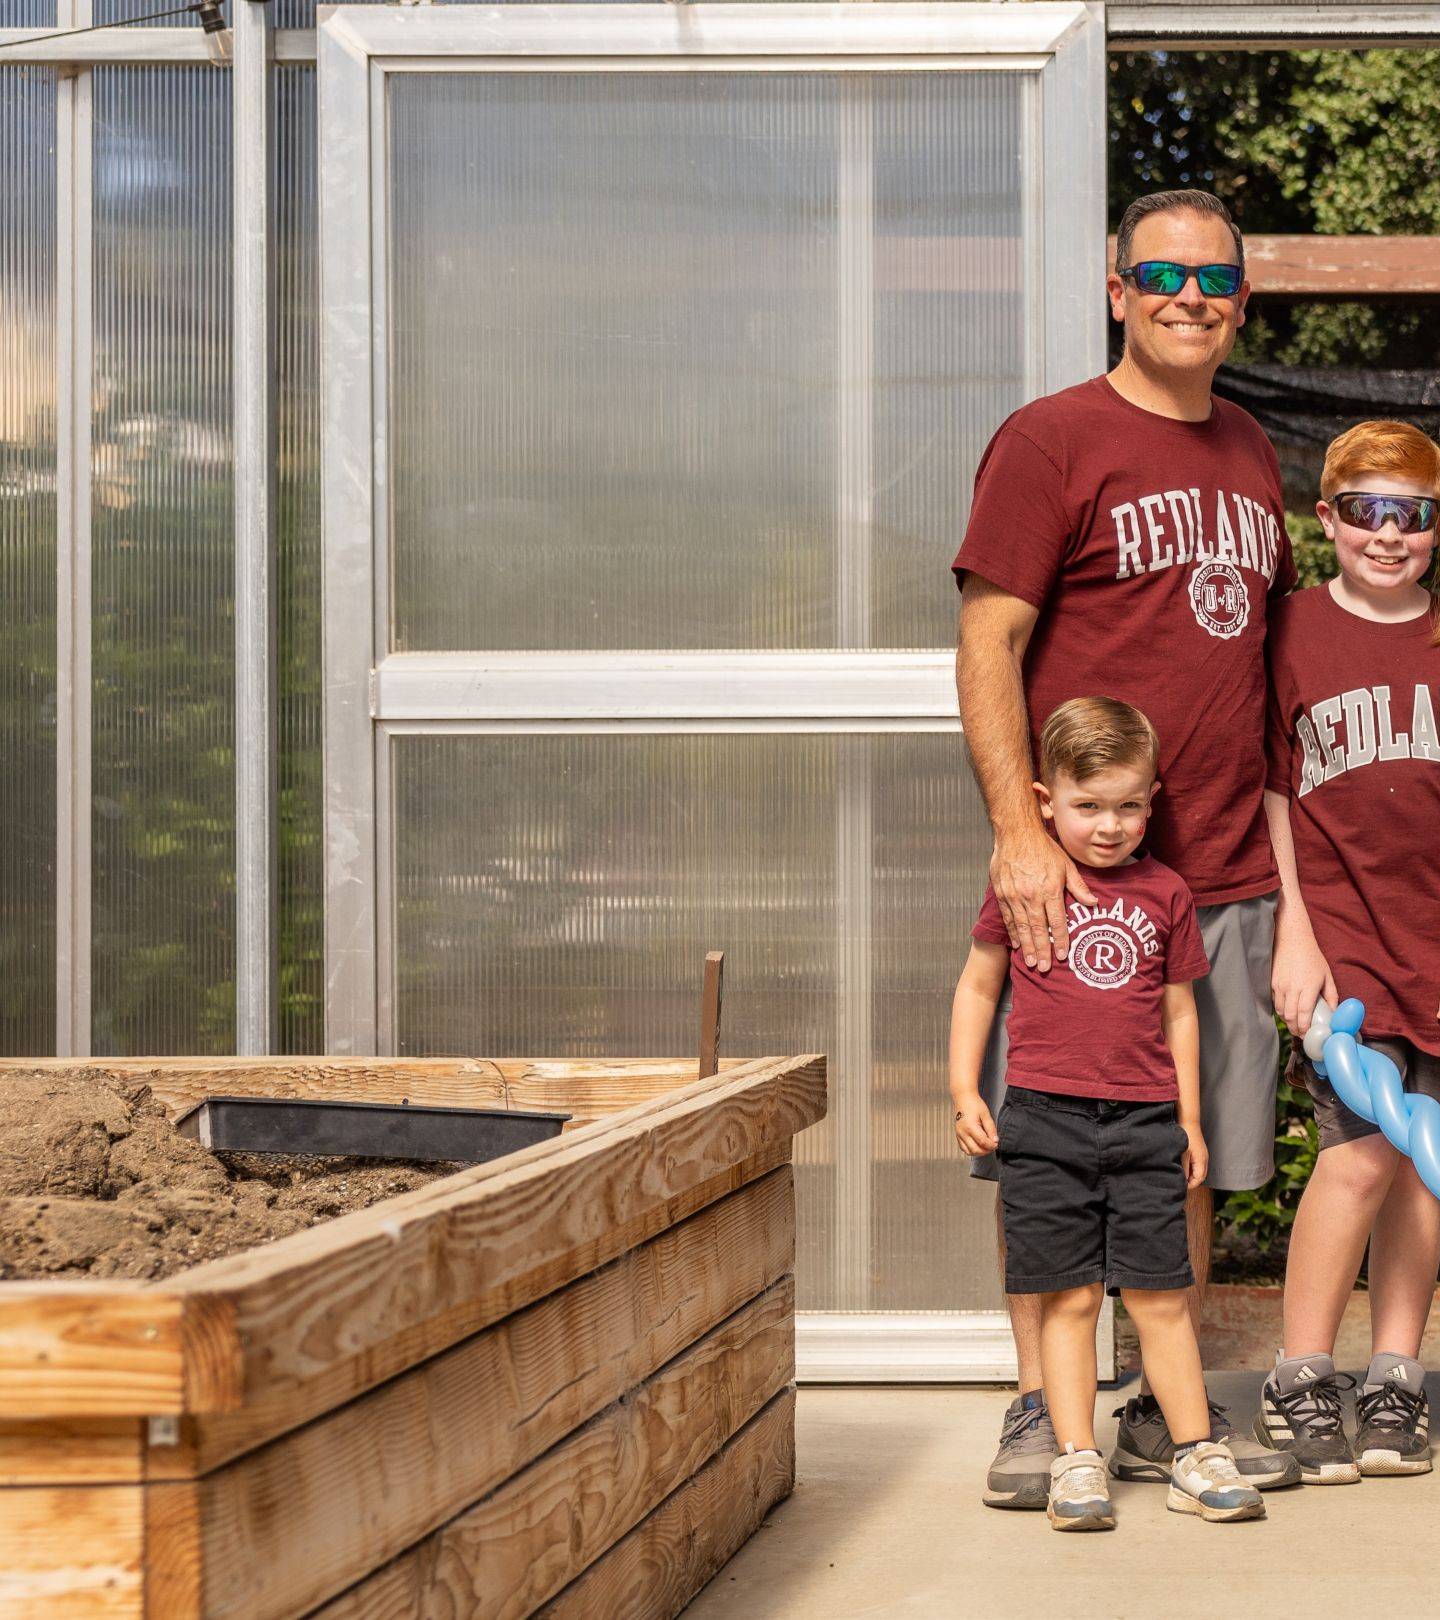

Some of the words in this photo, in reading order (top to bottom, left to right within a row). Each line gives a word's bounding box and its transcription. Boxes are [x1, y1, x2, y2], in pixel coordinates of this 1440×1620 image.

[1194, 566, 1213, 600] UNIVERSITY
[1226, 568, 1244, 603] REDLANDS
[1202, 584, 1218, 612] U
[1218, 594, 1226, 606] of
[1224, 585, 1239, 613] R
[1210, 622, 1222, 633] EST.
[1075, 932, 1104, 960] UNIVERSITY
[1114, 934, 1132, 970] REDLANDS
[1093, 944, 1117, 970] R
